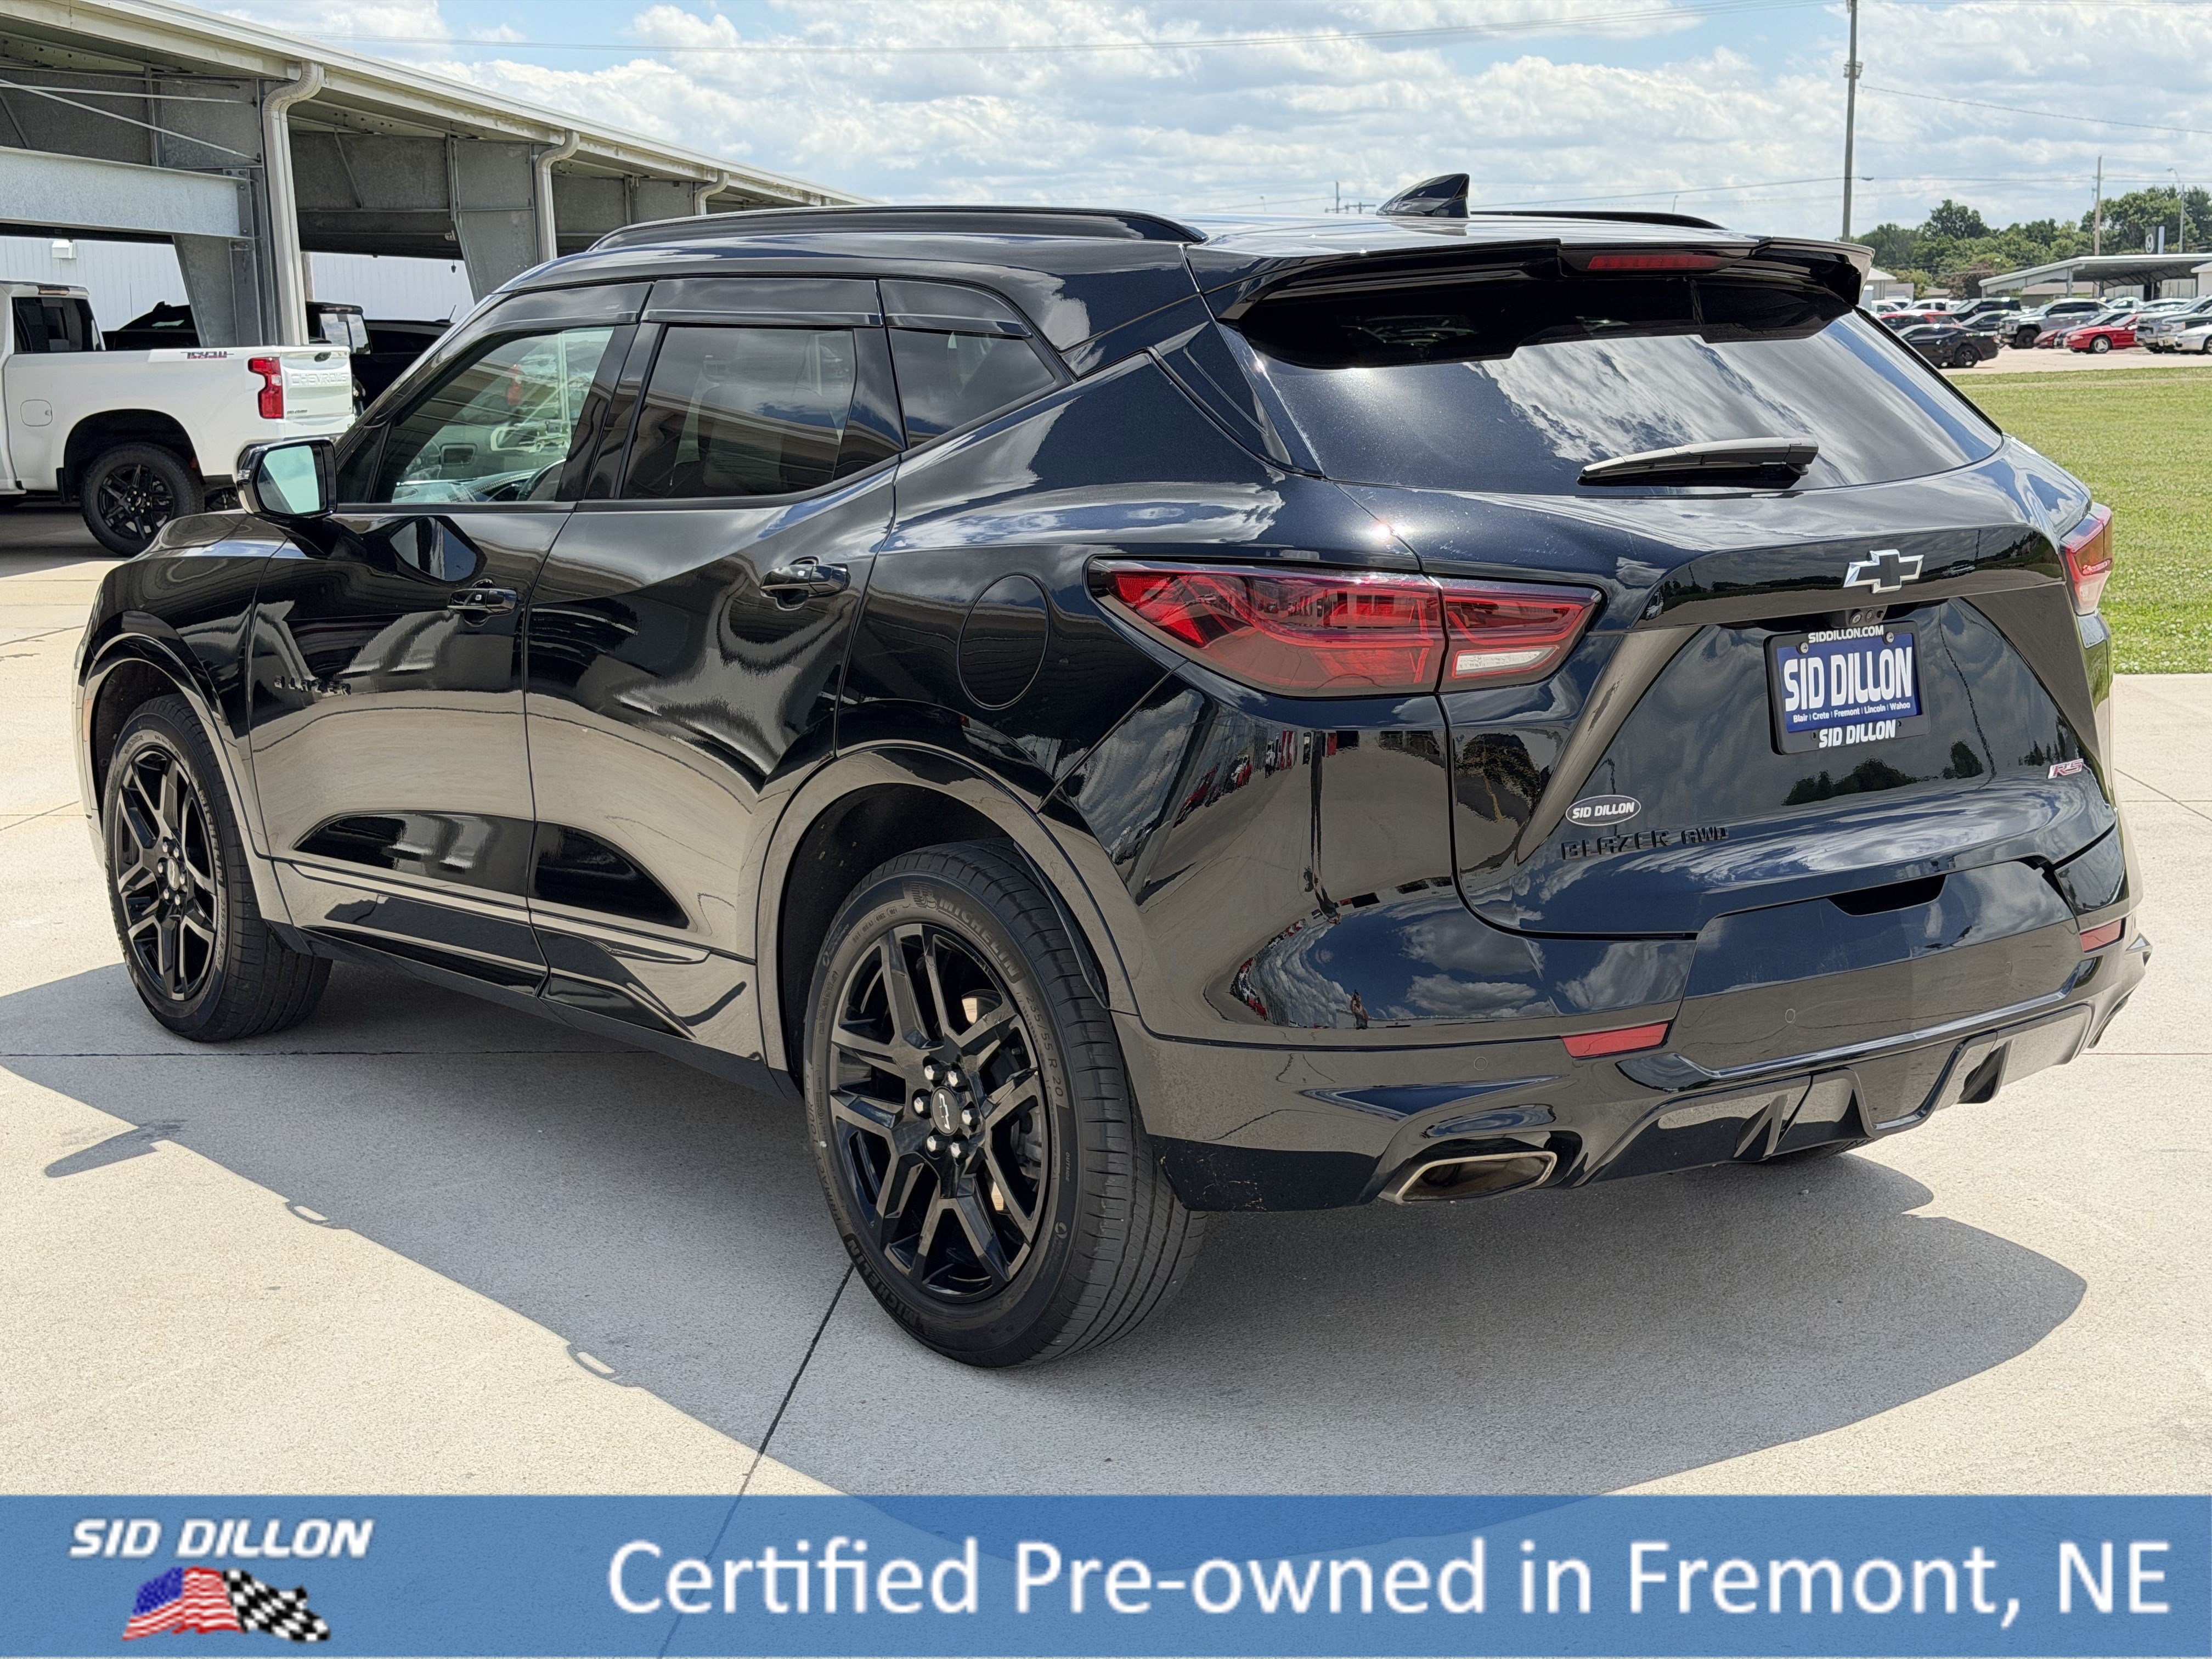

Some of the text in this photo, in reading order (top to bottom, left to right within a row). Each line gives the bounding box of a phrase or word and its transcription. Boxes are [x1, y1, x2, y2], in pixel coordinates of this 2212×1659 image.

[1808, 624, 1884, 644] SIDDILLON.COM
[1784, 646, 1912, 712] SID DILLON
[1793, 714, 1807, 723] Blair
[1834, 708, 1860, 718] Fremont
[1864, 705, 1886, 714] Lincoln
[1889, 702, 1910, 711] Wahoo
[1819, 719, 1896, 748] SID DILLON
[2048, 758, 2084, 779] RS
[1572, 802, 1635, 819] SID DILLON
[1561, 826, 1728, 860] BLAZER AWD
[939, 898, 1019, 977] MICHELIN
[1026, 995, 1054, 1051] 235/55
[1048, 1058, 1058, 1068] R
[1052, 1075, 1064, 1097] 20
